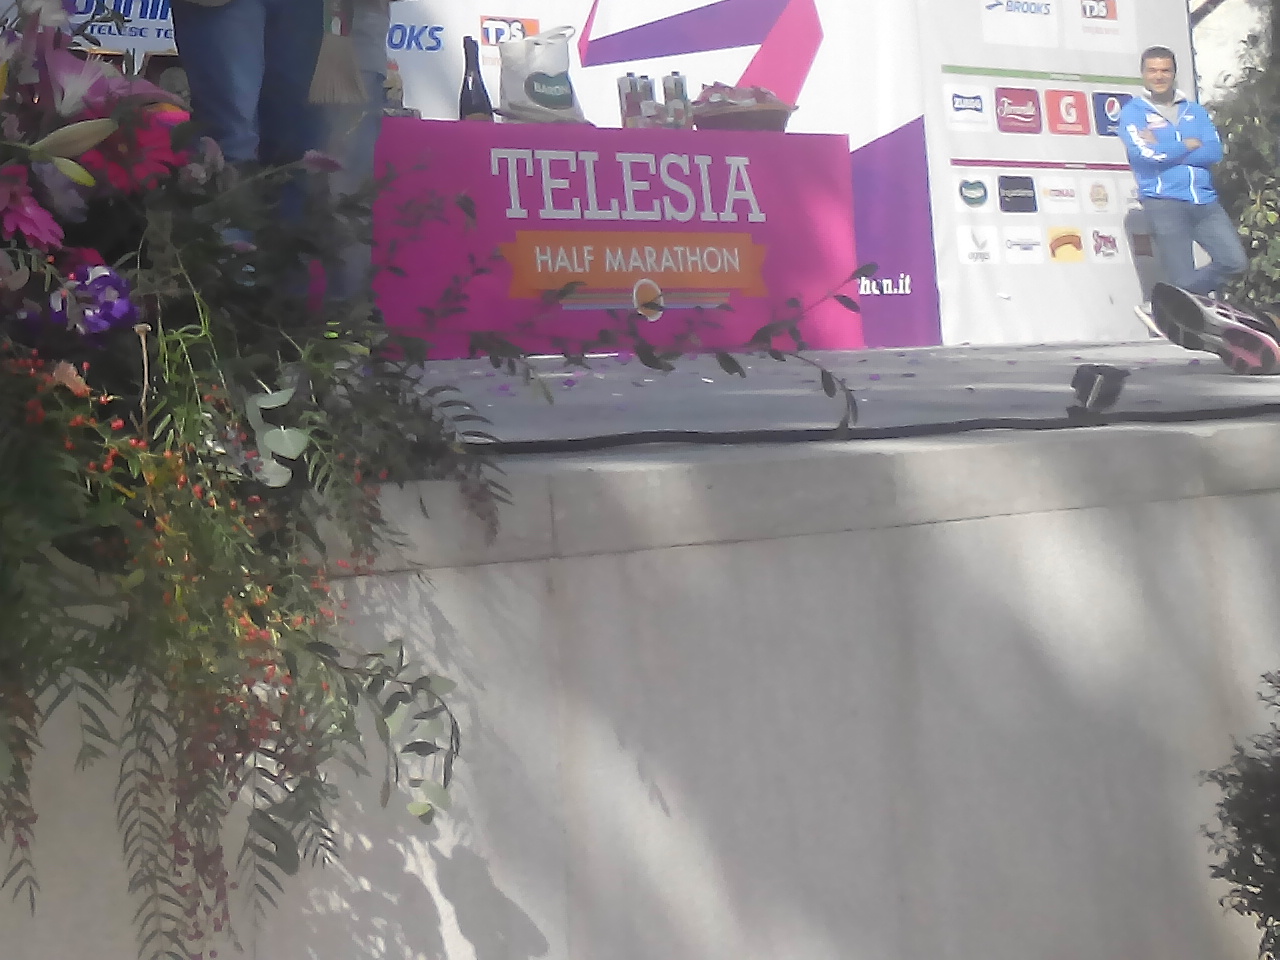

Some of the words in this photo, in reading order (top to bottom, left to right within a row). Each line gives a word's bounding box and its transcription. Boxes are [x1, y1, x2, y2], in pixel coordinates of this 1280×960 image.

[1005, 0, 1051, 15] BROOKS
[1081, 0, 1107, 18] TDS
[482, 18, 526, 46] TDS
[490, 147, 766, 223] TELESIA
[535, 244, 595, 274] HALF
[604, 245, 741, 274] MARATHON
